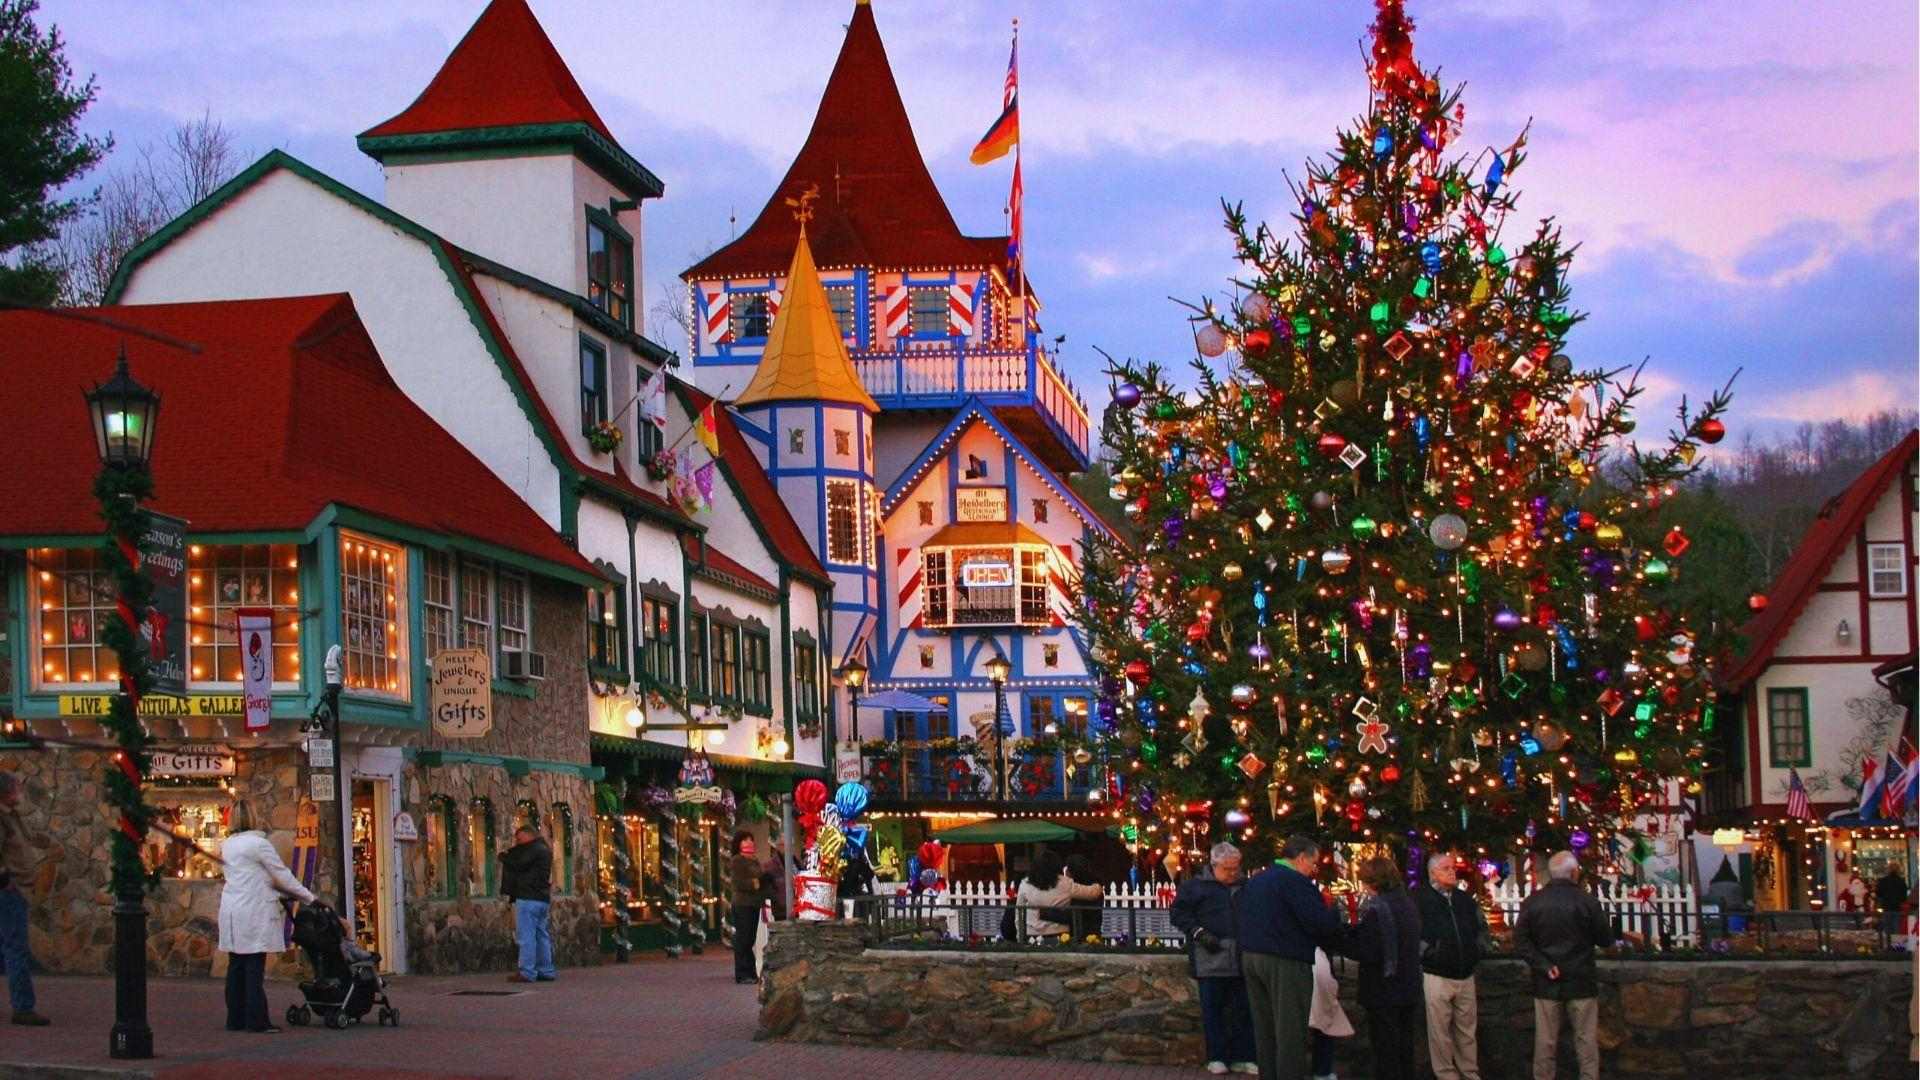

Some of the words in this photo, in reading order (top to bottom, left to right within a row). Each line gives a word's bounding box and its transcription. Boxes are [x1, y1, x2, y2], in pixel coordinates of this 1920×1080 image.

[959, 498, 1006, 512] Heidelberg
[966, 566, 1009, 583] OPEN
[435, 664, 486, 685] Jewelers
[443, 687, 478, 695] UNIQUE
[72, 697, 102, 714] LIVE
[438, 699, 486, 728] Gifts
